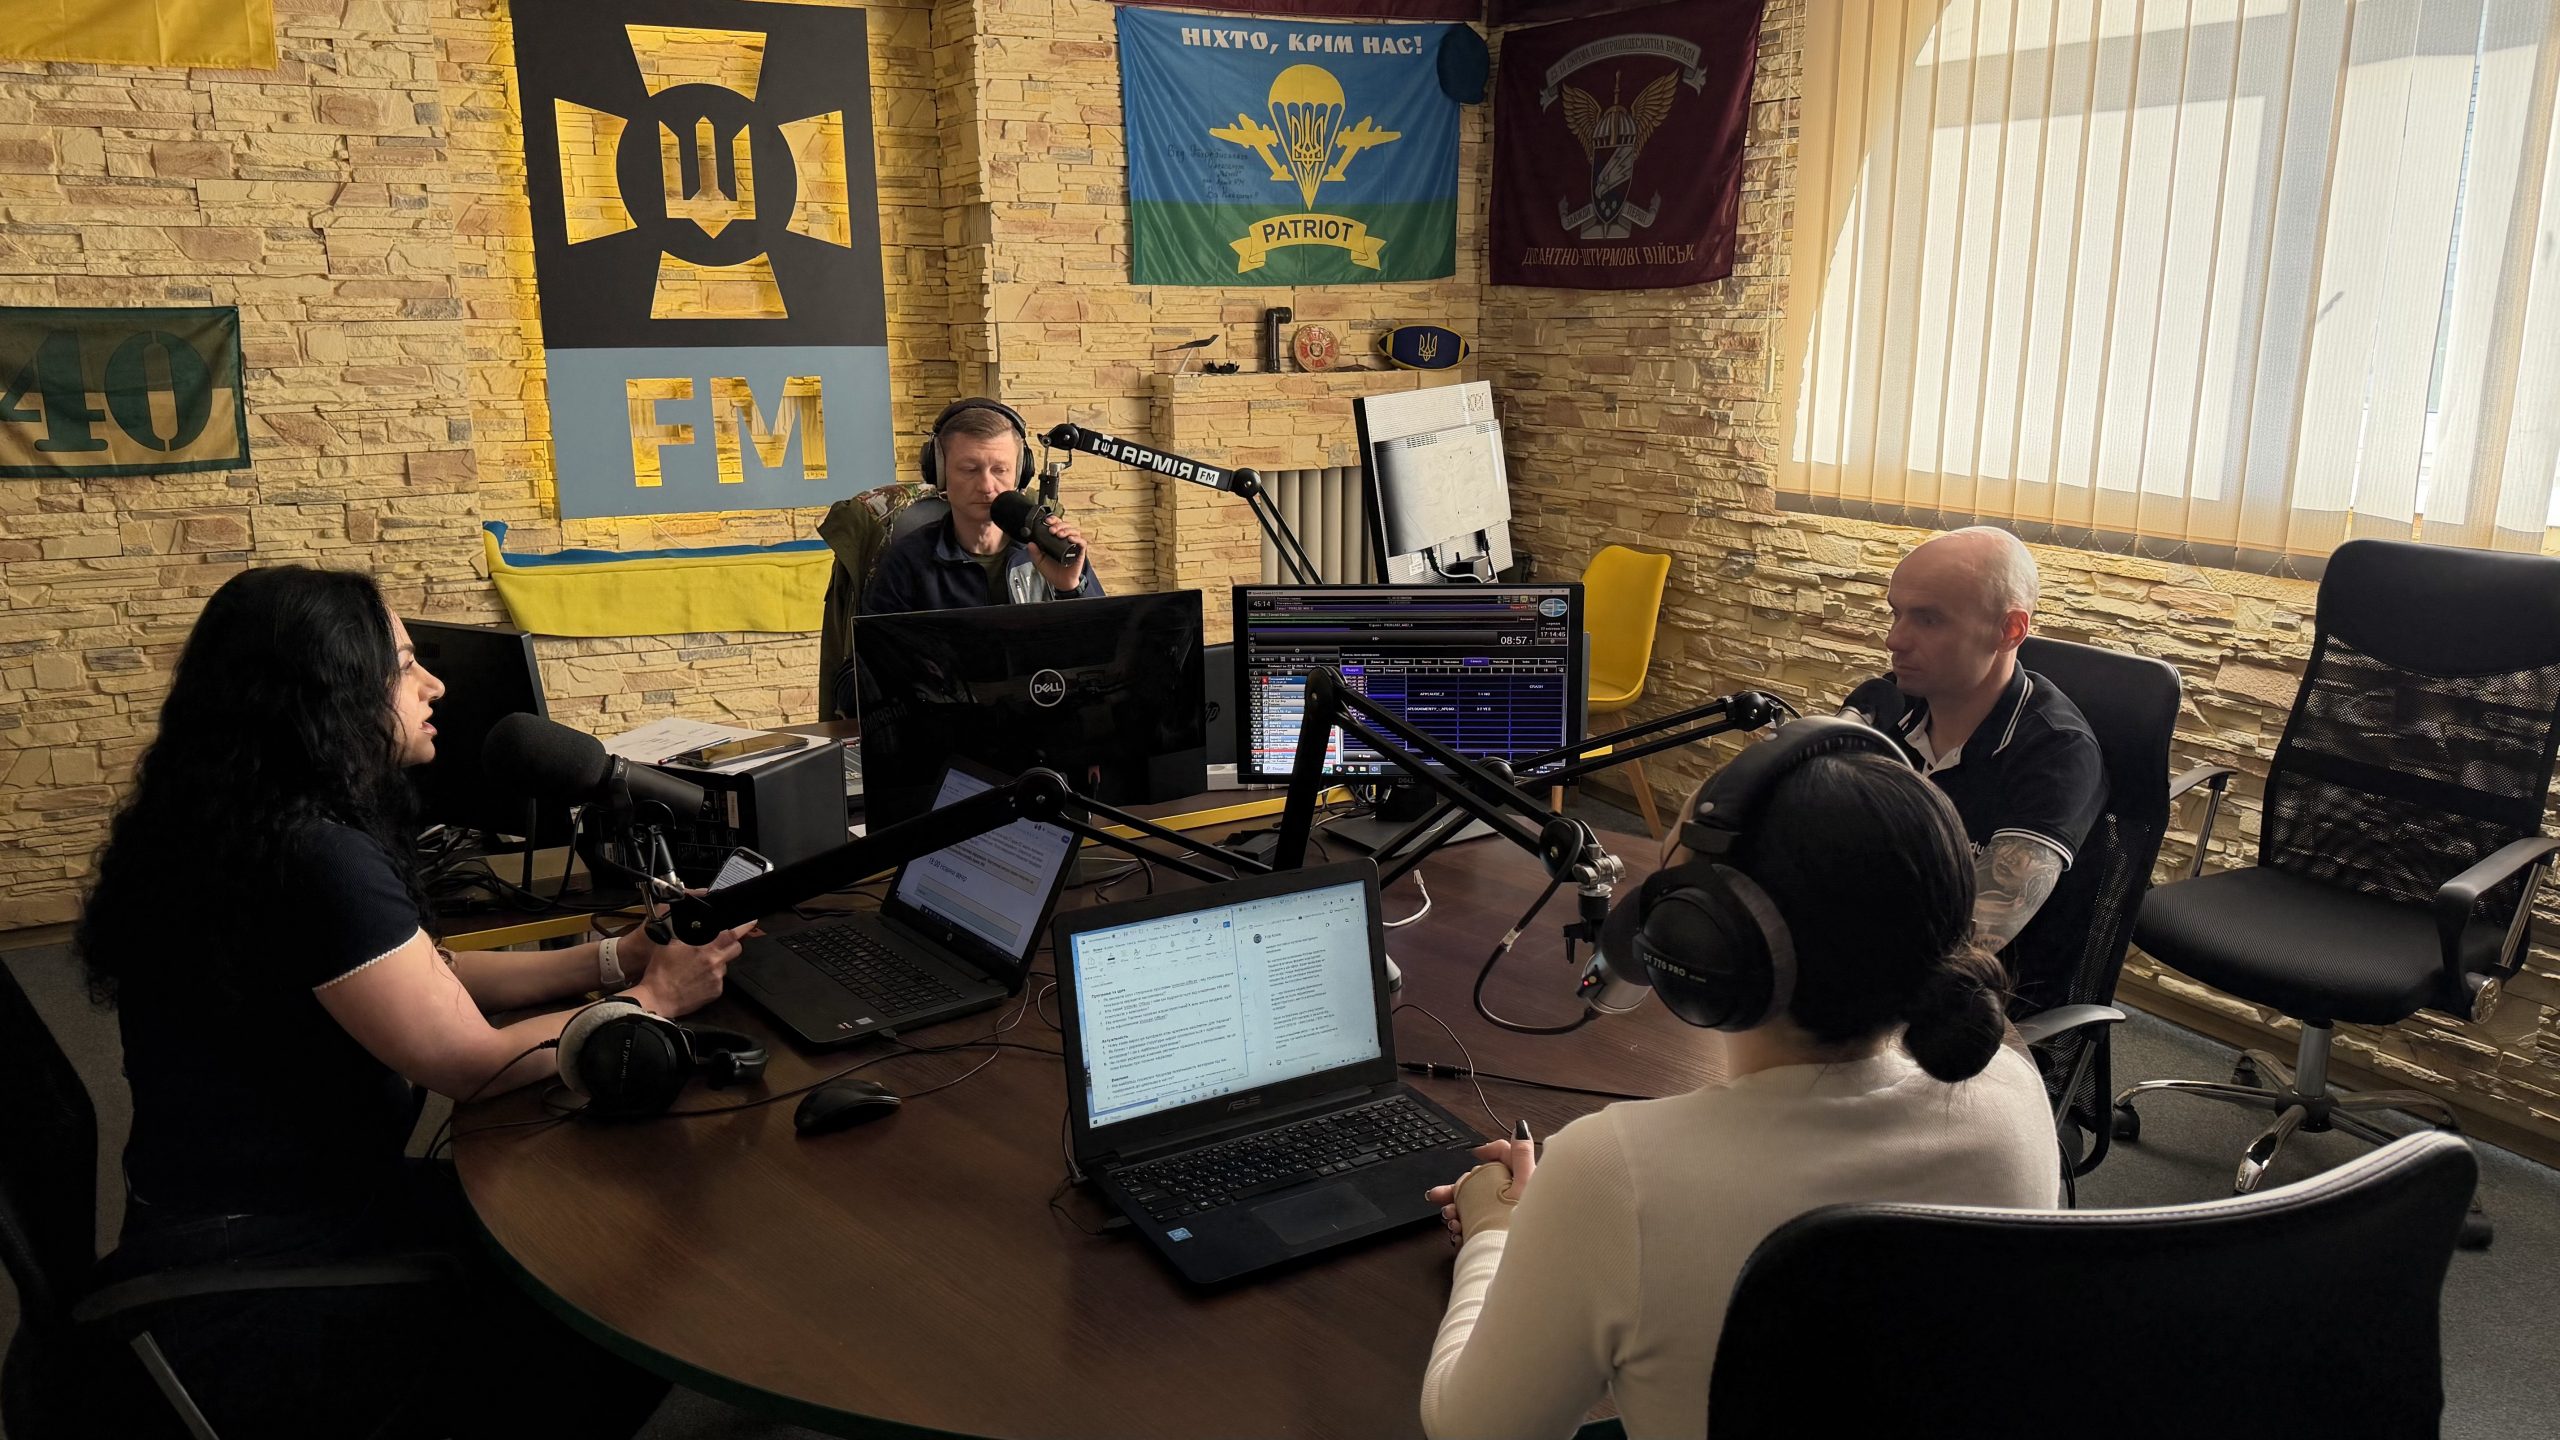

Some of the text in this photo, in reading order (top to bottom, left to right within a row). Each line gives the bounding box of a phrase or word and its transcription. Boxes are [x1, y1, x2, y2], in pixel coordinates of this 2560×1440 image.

[1181, 27, 1422, 55] НІХТО, КРІМ НАС!
[1665, 40, 1695, 63] БРИГАДА
[1262, 219, 1354, 244] PATRIOT
[0, 328, 213, 453] 40
[625, 375, 829, 488] FM
[1121, 446, 1216, 483] АРМІЯ FM
[1500, 635, 1528, 645] 08:57
[1034, 683, 1062, 694] DELL
[1642, 952, 1687, 978] DT 770 PRO
